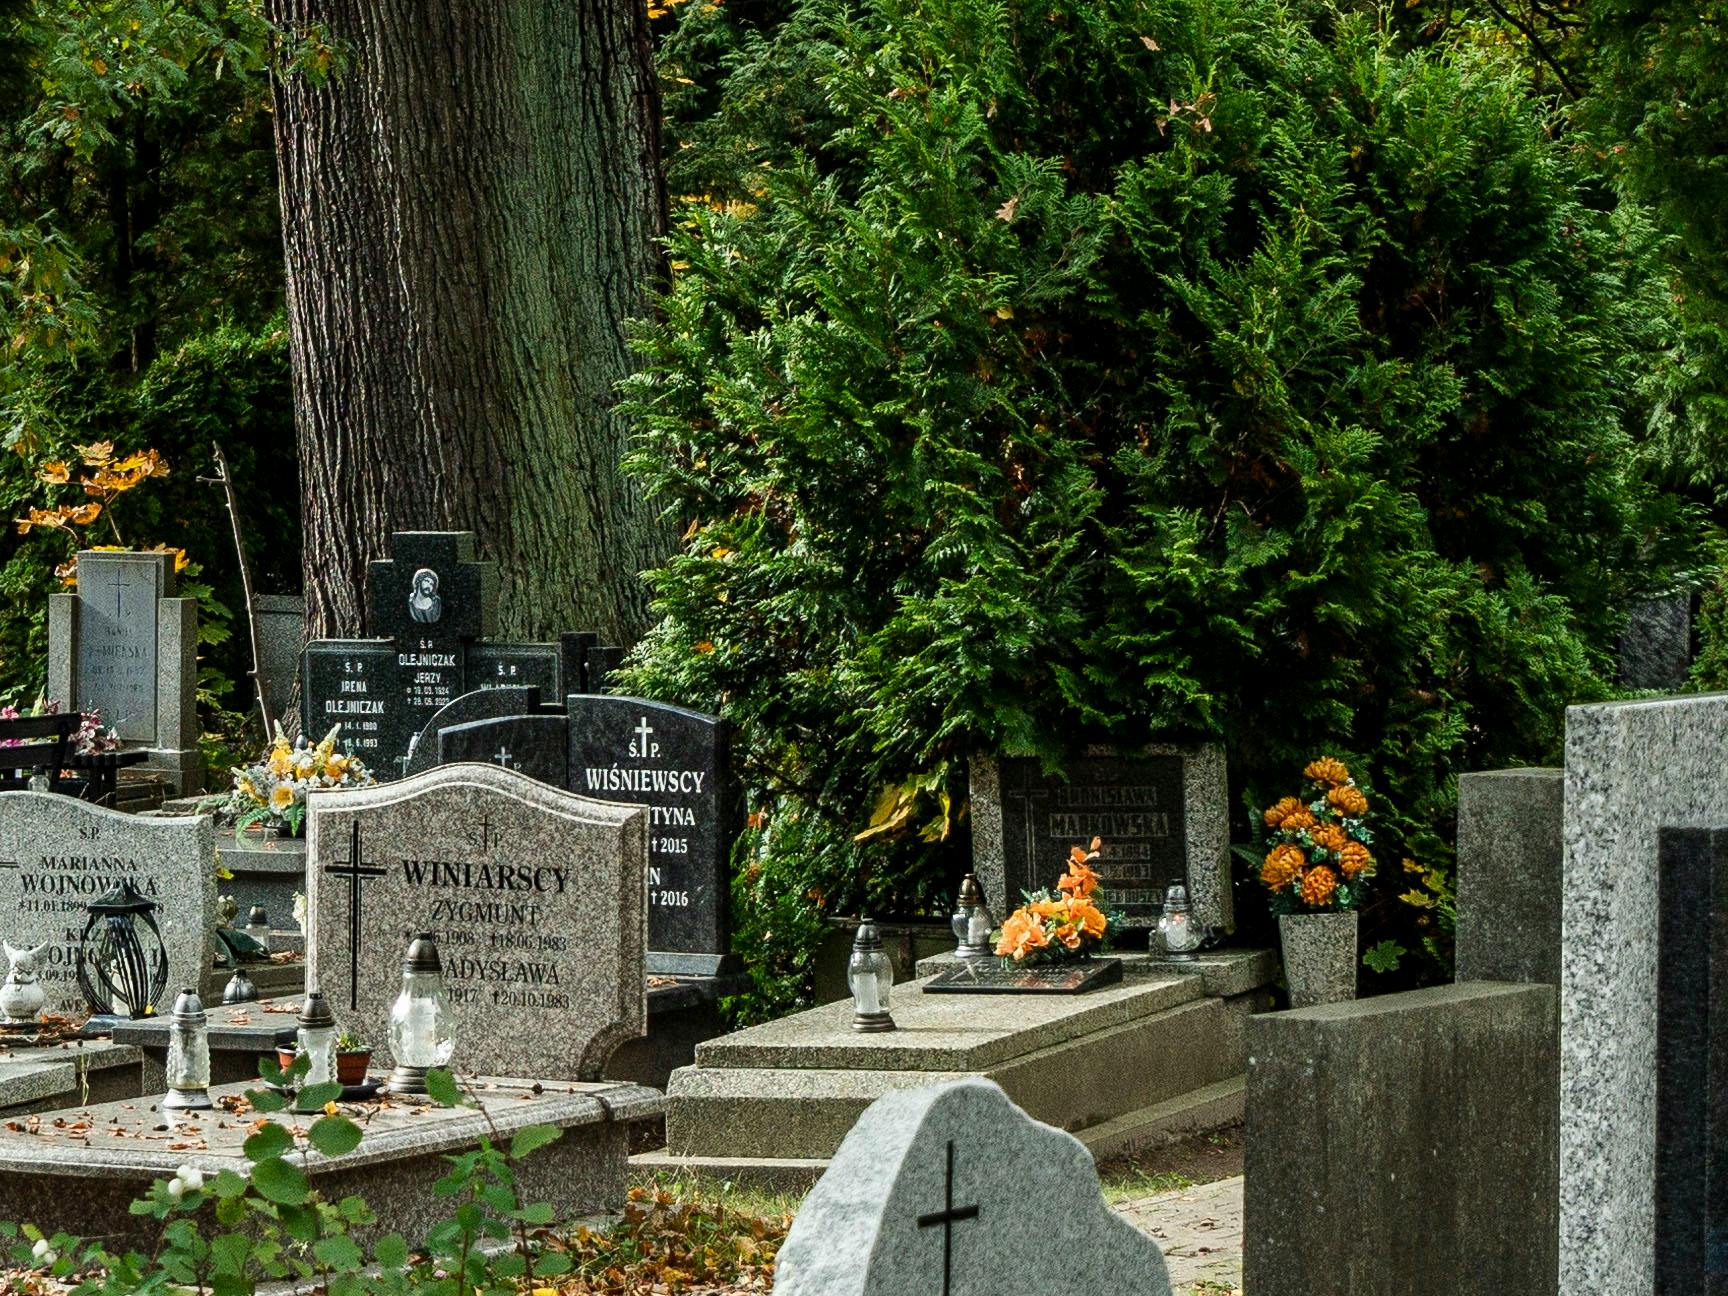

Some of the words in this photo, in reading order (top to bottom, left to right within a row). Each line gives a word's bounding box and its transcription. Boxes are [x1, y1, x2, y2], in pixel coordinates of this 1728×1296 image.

[399, 654, 456, 666] OLEJNICZAK
[414, 672, 441, 684] JERZY
[340, 680, 367, 693] IRENA
[325, 700, 385, 714] OLEJNICZAK
[585, 762, 705, 793] WIŚNIEWSCY
[660, 838, 688, 854] 2015
[41, 856, 138, 872] MARIANNA
[401, 859, 570, 893] WINIARSCY
[21, 874, 158, 896] WOJNOWKA
[660, 890, 689, 907] 2016
[431, 899, 541, 925] ZYGMUNT
[444, 957, 560, 985] ADYSŁAWA
